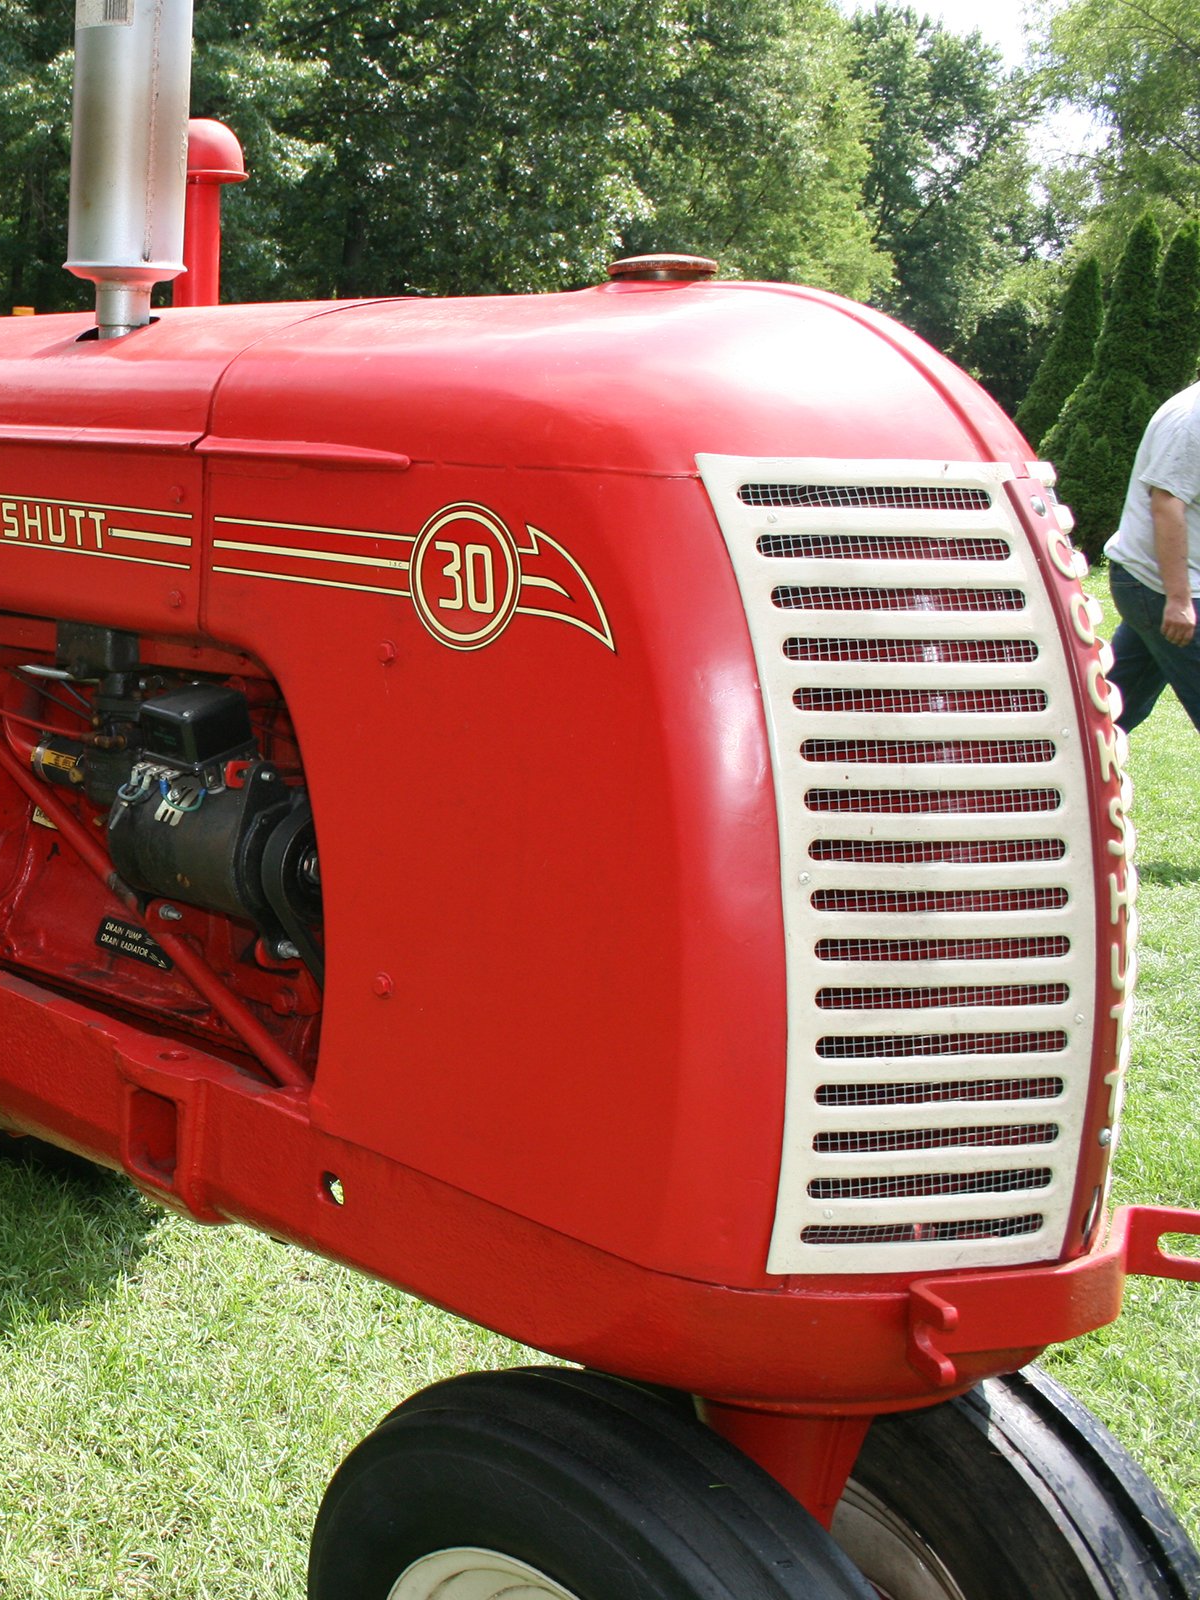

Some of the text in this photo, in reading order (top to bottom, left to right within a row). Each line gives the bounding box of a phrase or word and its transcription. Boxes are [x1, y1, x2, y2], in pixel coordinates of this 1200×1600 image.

[434, 541, 495, 614] 30
[105, 922, 142, 941] DRAIN PUMP
[100, 933, 149, 957] DRAIN RADIATOR
